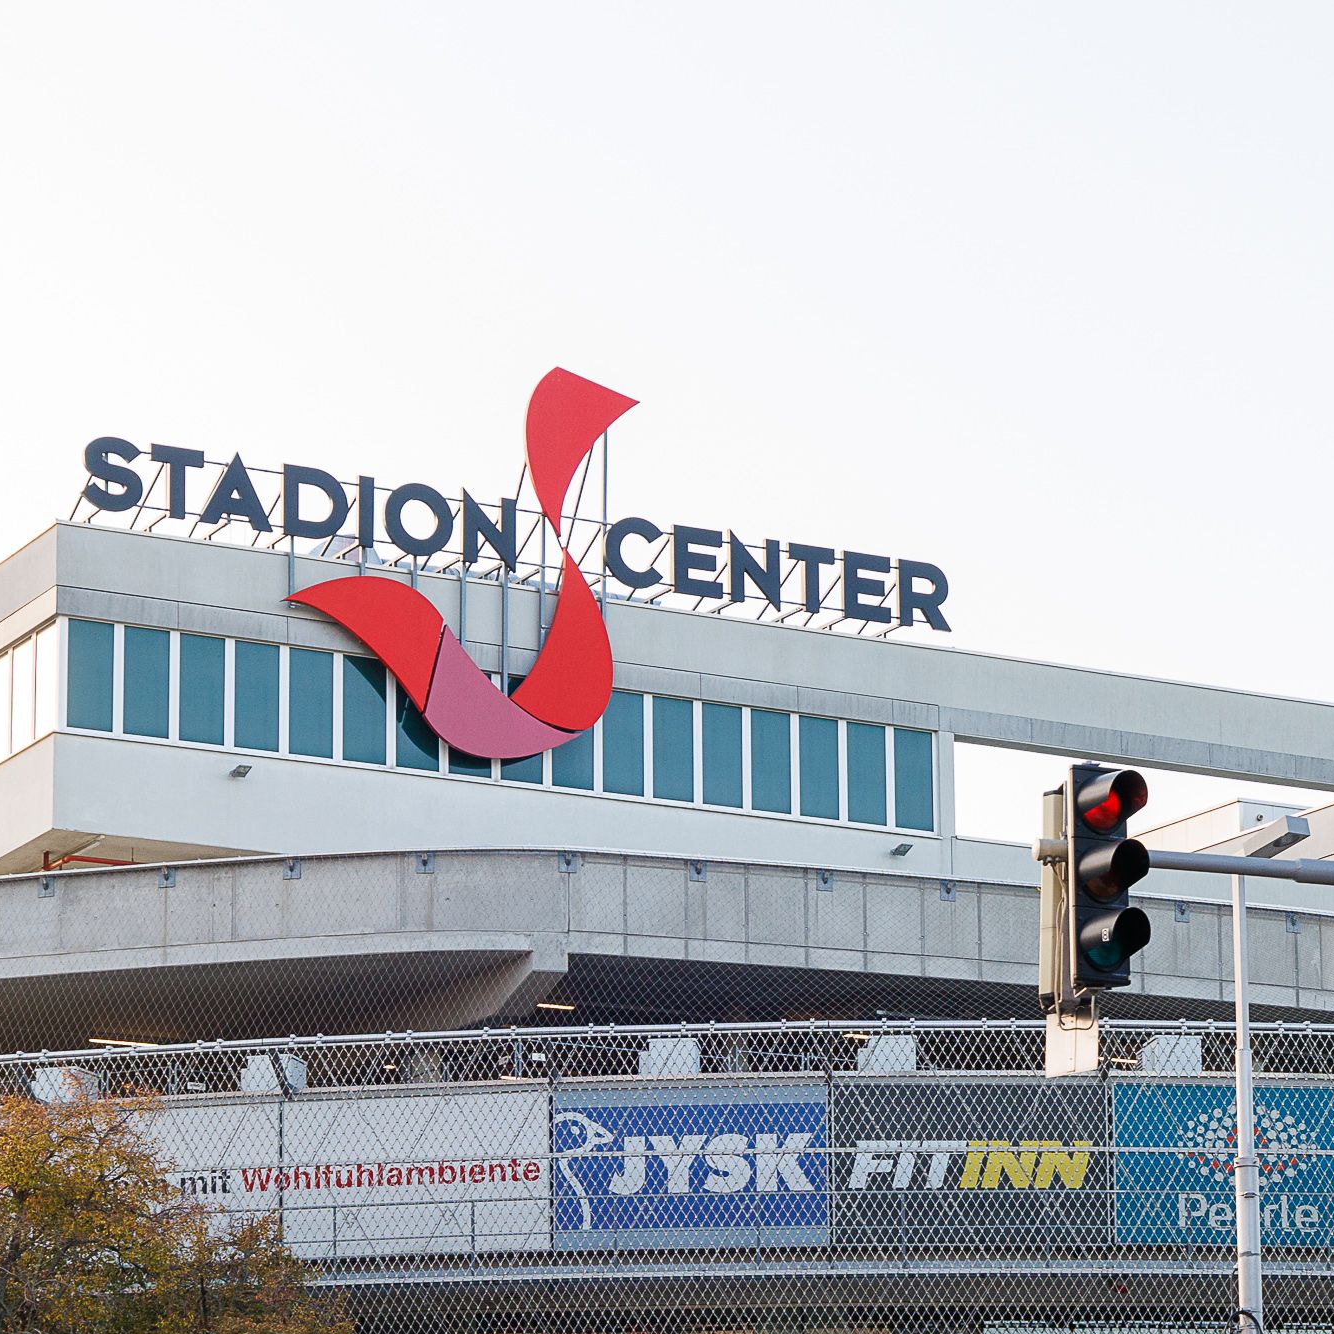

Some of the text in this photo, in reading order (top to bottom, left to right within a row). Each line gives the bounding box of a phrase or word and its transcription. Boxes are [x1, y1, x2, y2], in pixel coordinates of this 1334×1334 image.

[81, 436, 517, 572] STADION
[604, 516, 952, 633] CENTER
[180, 1169, 231, 1195] mit
[609, 1131, 815, 1196] JYSK
[1178, 1192, 1320, 1233] Perle
